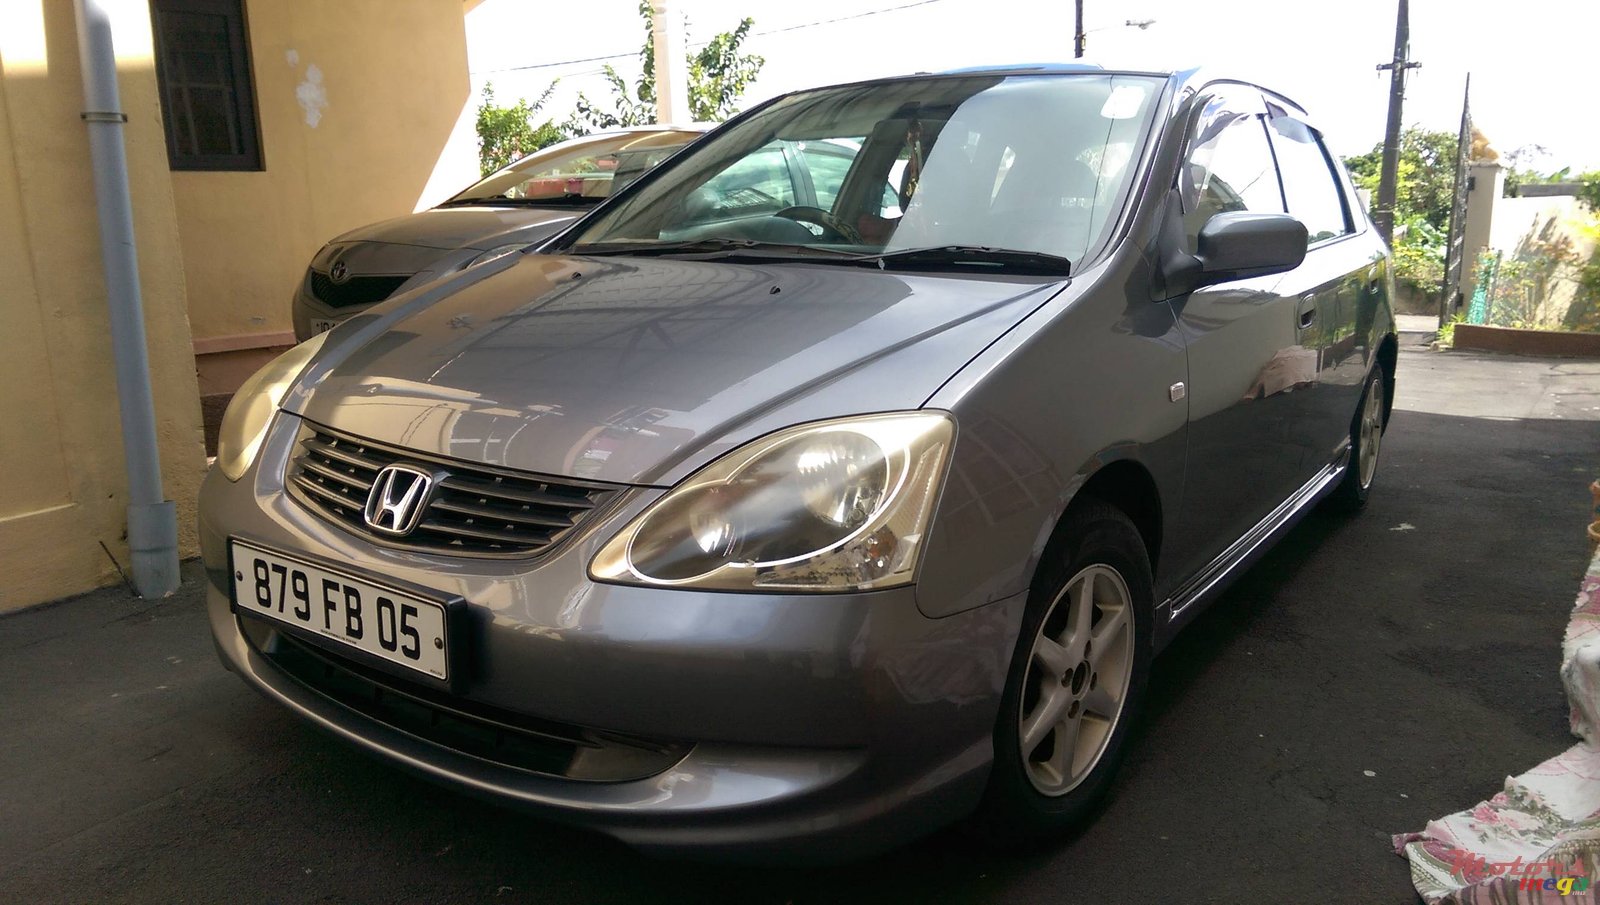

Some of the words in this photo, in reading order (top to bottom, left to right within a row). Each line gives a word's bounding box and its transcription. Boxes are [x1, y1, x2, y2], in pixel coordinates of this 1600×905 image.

[254, 558, 310, 622] 879
[322, 578, 364, 640] FB
[376, 596, 421, 661] 05
